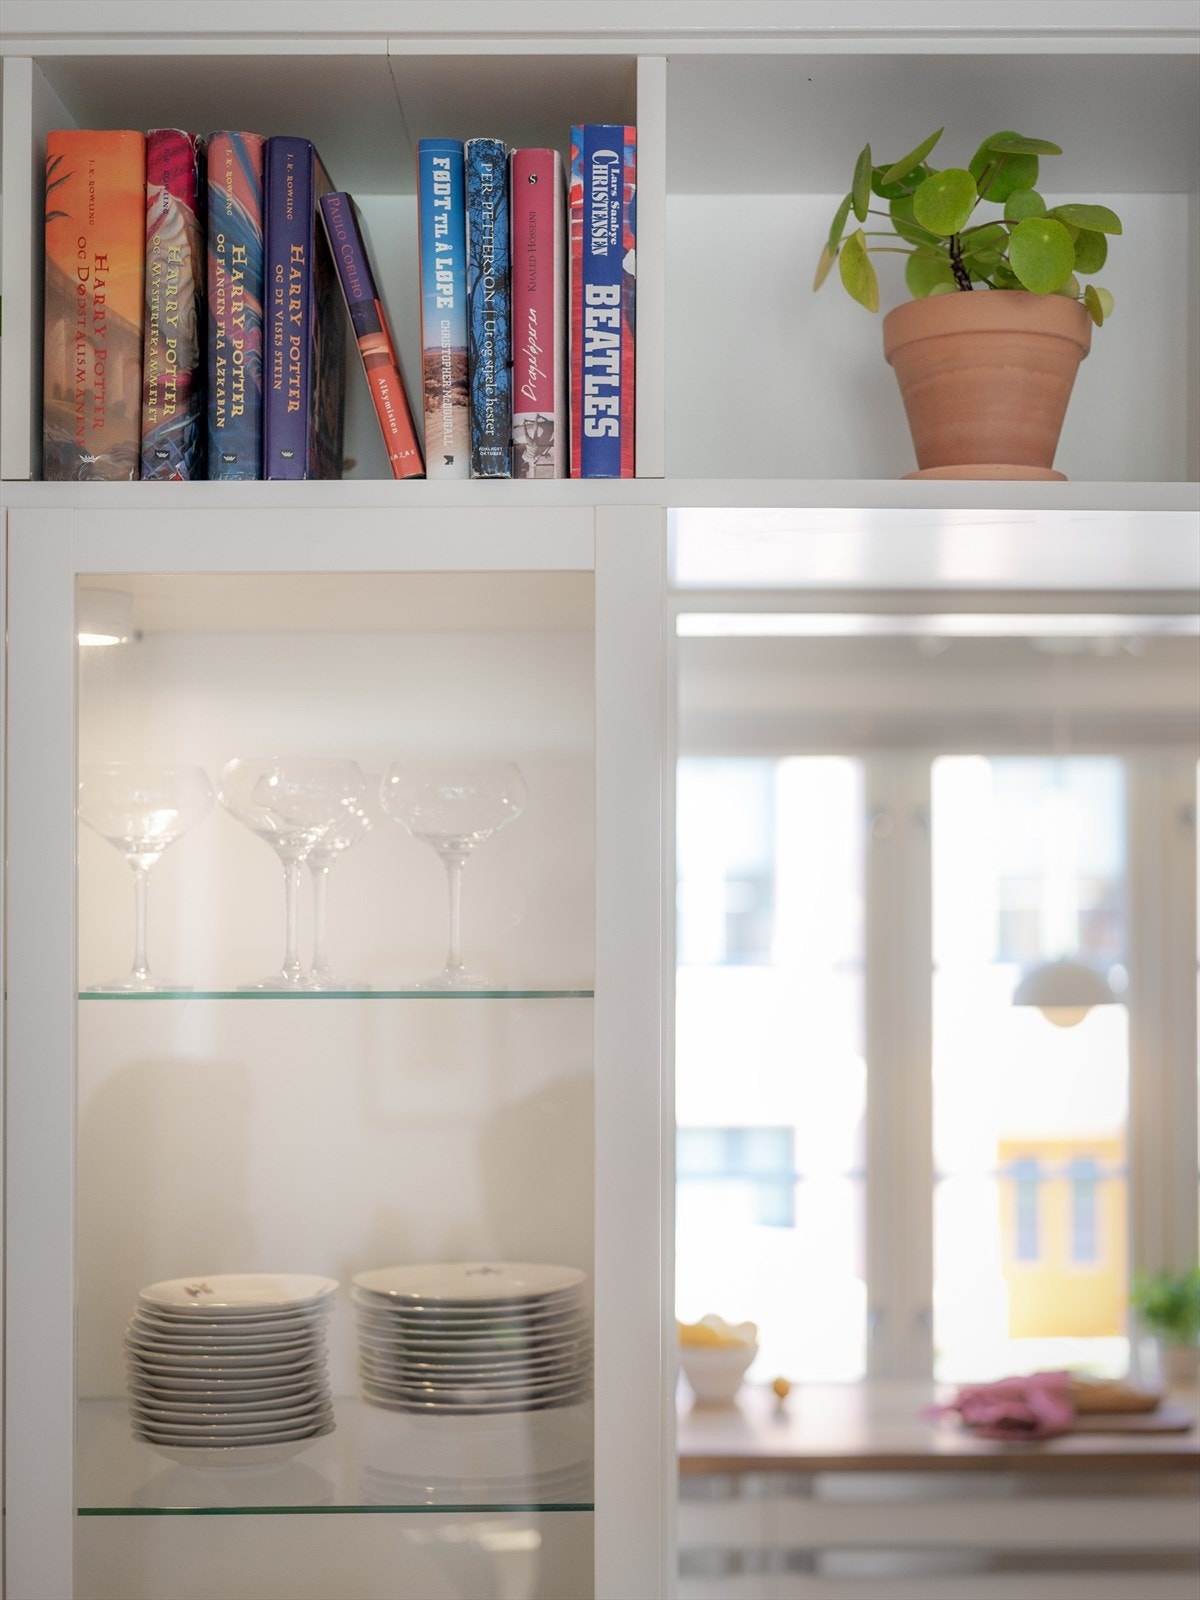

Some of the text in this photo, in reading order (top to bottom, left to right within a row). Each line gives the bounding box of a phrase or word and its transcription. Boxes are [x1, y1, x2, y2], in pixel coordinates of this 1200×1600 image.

[77, 236, 87, 260] OG
[286, 175, 294, 220] ROWLING
[328, 197, 363, 298] PAULO COELHO
[432, 157, 454, 309] FØDT TIL Å LØPE
[481, 163, 496, 302] PER PETTERSON
[527, 211, 537, 292] KHALED HOSSEINI
[591, 149, 620, 257] CHRISTENSEN
[609, 168, 620, 245] Lars Saabye
[93, 253, 109, 429] HARRY POTTER
[149, 235, 161, 424] OG MYSTERIEKAMMERET
[163, 245, 182, 416] HARRY POTTER
[216, 233, 227, 428] OG FANGEN FRA AZKABAN
[231, 244, 248, 418] HARRY POTTER
[273, 264, 284, 390] OG DE VISES STEIN
[287, 244, 305, 413] HARRY POTTER
[440, 320, 454, 446] CHRISTOPHER McDOUGALL
[481, 320, 498, 436] Ut og stjæle hester
[520, 307, 547, 402] Drageløperen
[584, 283, 621, 438] BEATLES
[378, 378, 398, 434] Alkymisten
